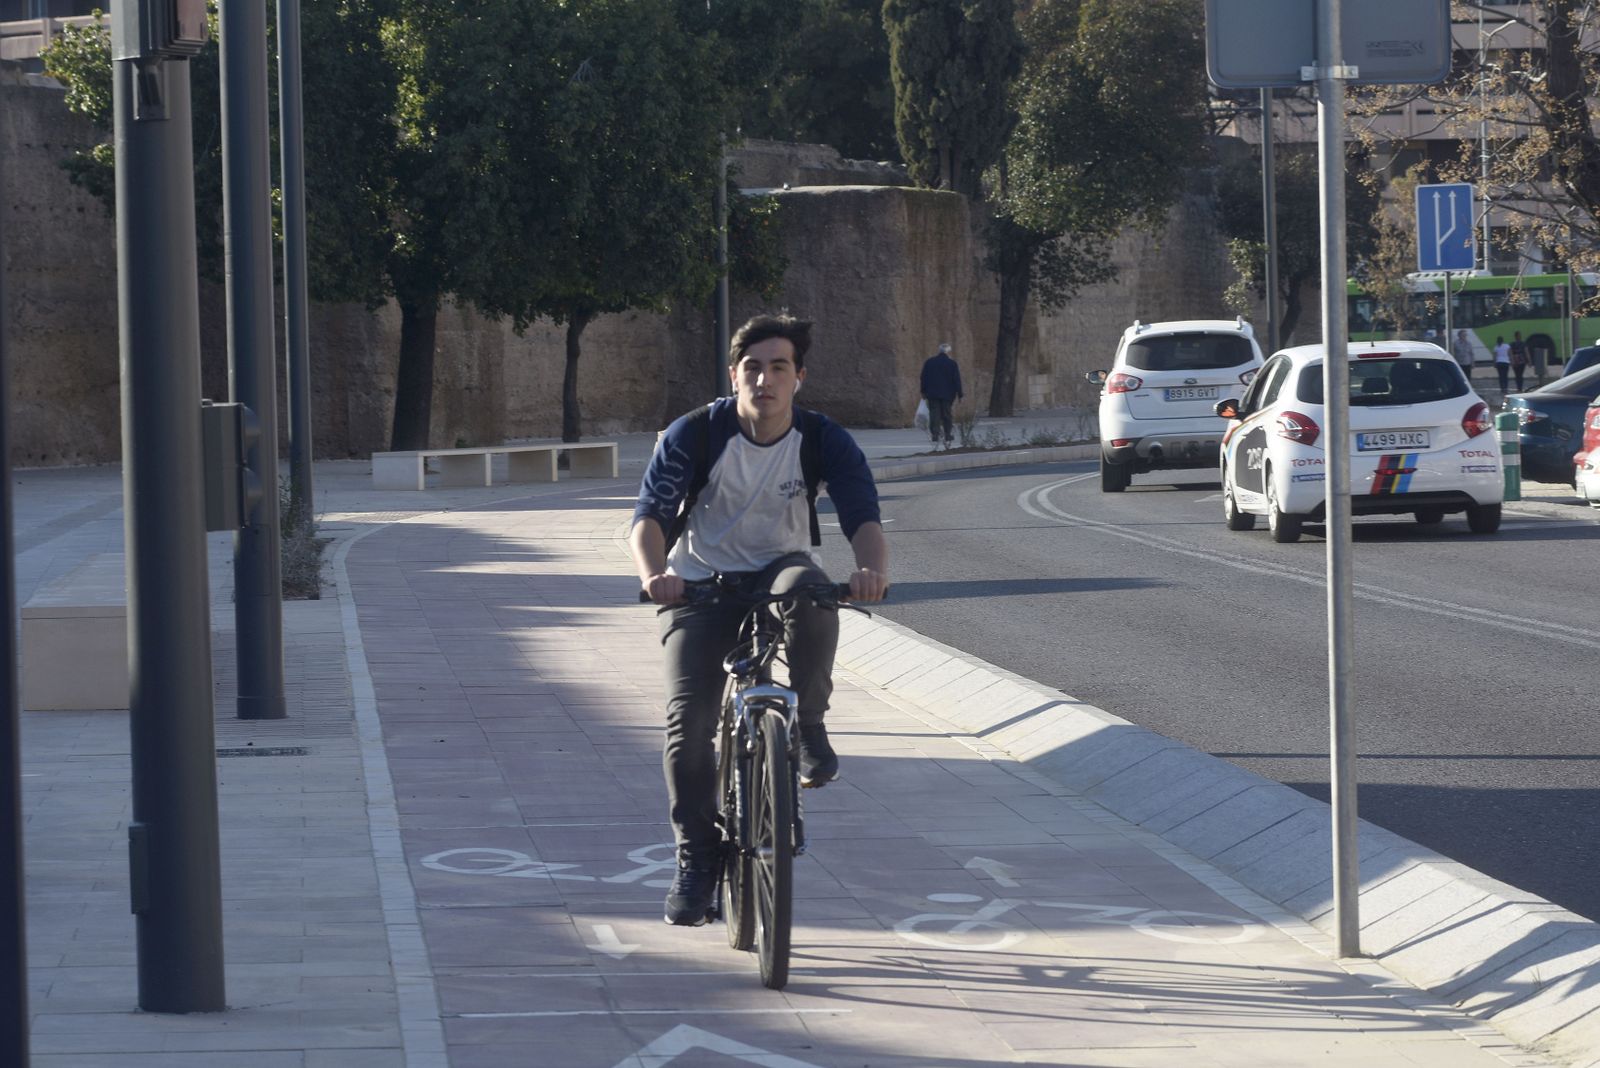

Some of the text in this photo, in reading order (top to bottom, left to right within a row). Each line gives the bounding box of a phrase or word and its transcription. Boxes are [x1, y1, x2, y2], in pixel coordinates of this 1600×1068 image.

[1170, 388, 1216, 398] 8915 GVT
[1364, 433, 1424, 447] 4499 HXC
[1457, 449, 1495, 458] TOTAL
